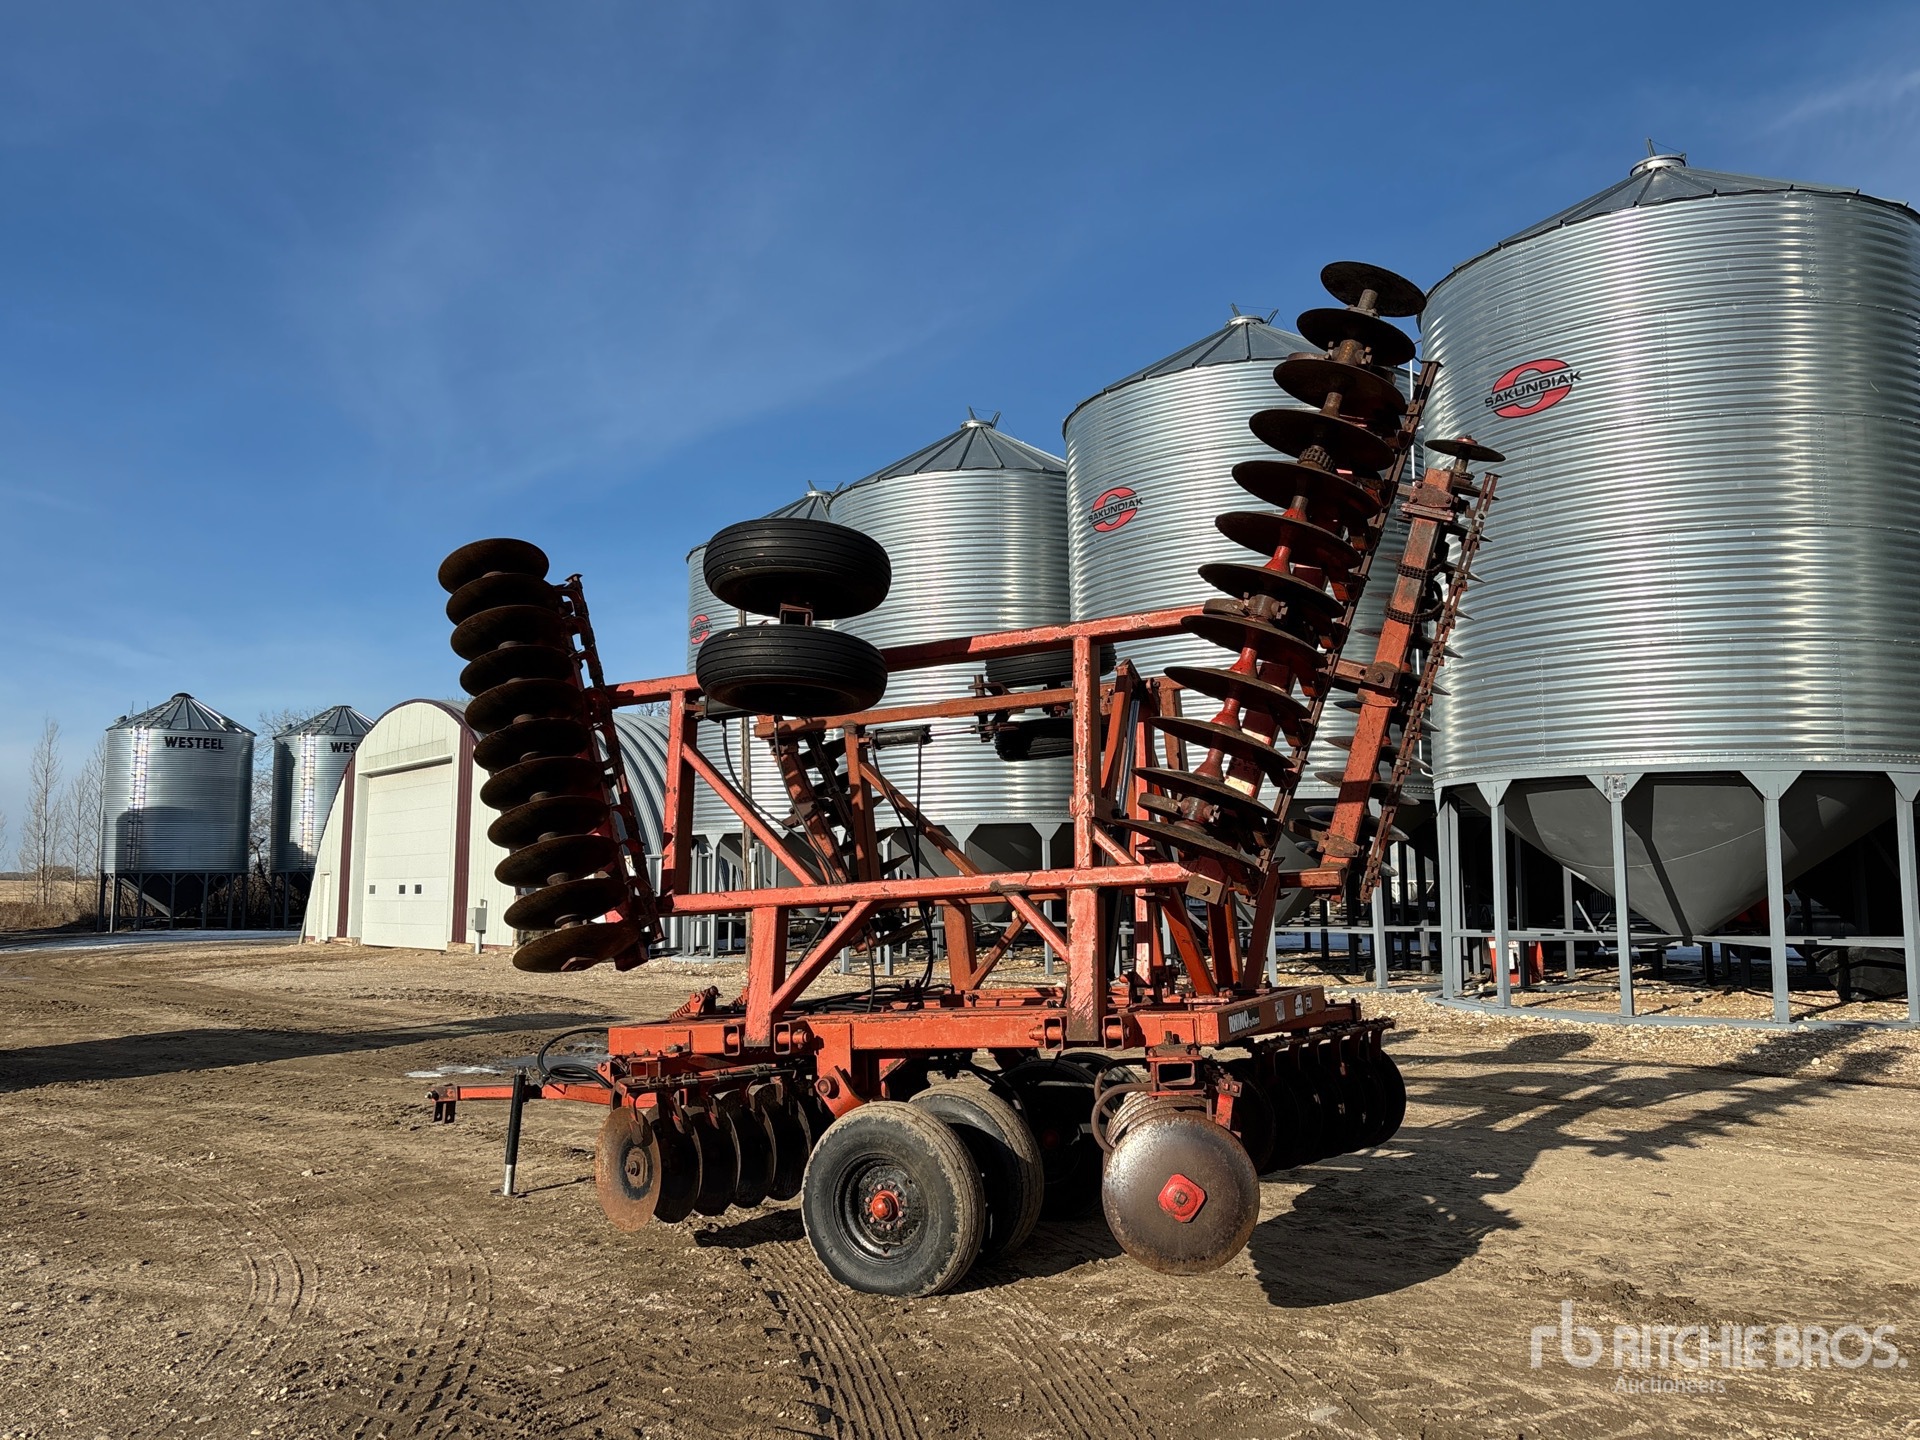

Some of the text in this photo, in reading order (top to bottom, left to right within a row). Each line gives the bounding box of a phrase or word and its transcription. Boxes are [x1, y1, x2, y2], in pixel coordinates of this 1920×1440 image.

[1484, 371, 1582, 408] SAKUNDIAK
[1088, 497, 1144, 523] SAKUNDIAK
[164, 736, 225, 750] WESTEEL
